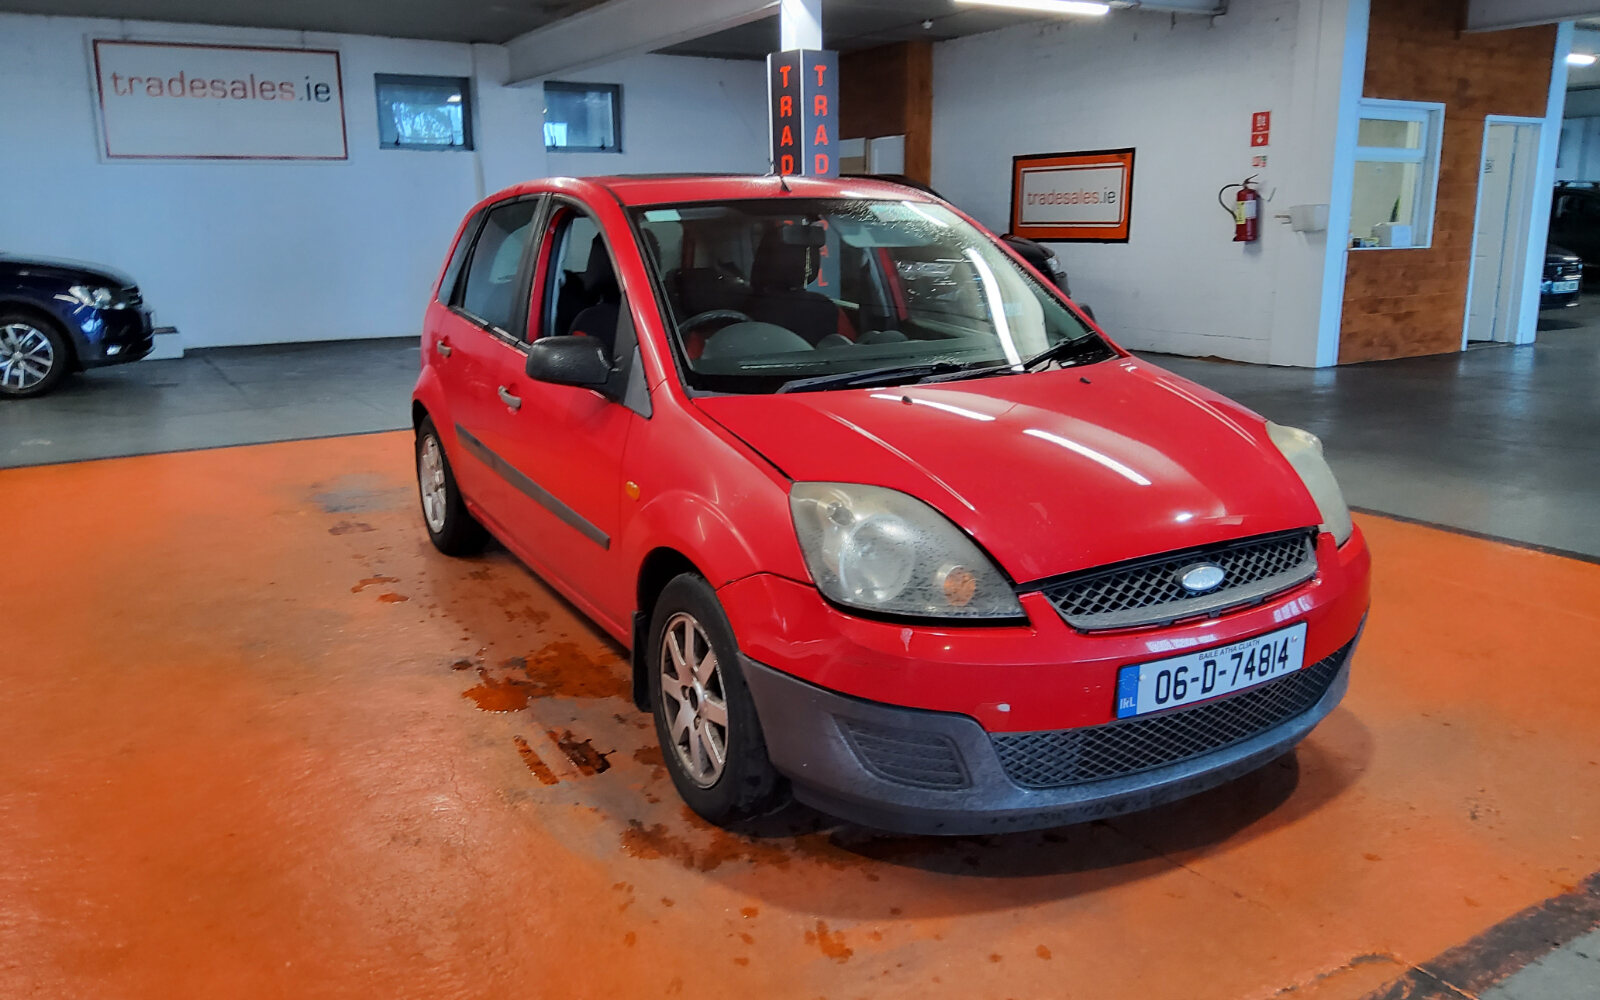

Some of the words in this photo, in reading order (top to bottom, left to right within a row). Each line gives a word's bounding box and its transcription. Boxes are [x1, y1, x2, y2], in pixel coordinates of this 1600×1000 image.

[110, 70, 331, 102] tradesales.ie
[779, 64, 794, 176] TRAD
[813, 64, 829, 175] TRAD
[1027, 186, 1116, 206] tradesales.ie
[1155, 637, 1289, 705] 06-D-74814
[1199, 650, 1218, 660] BAILE
[1119, 696, 1136, 710] IRL
